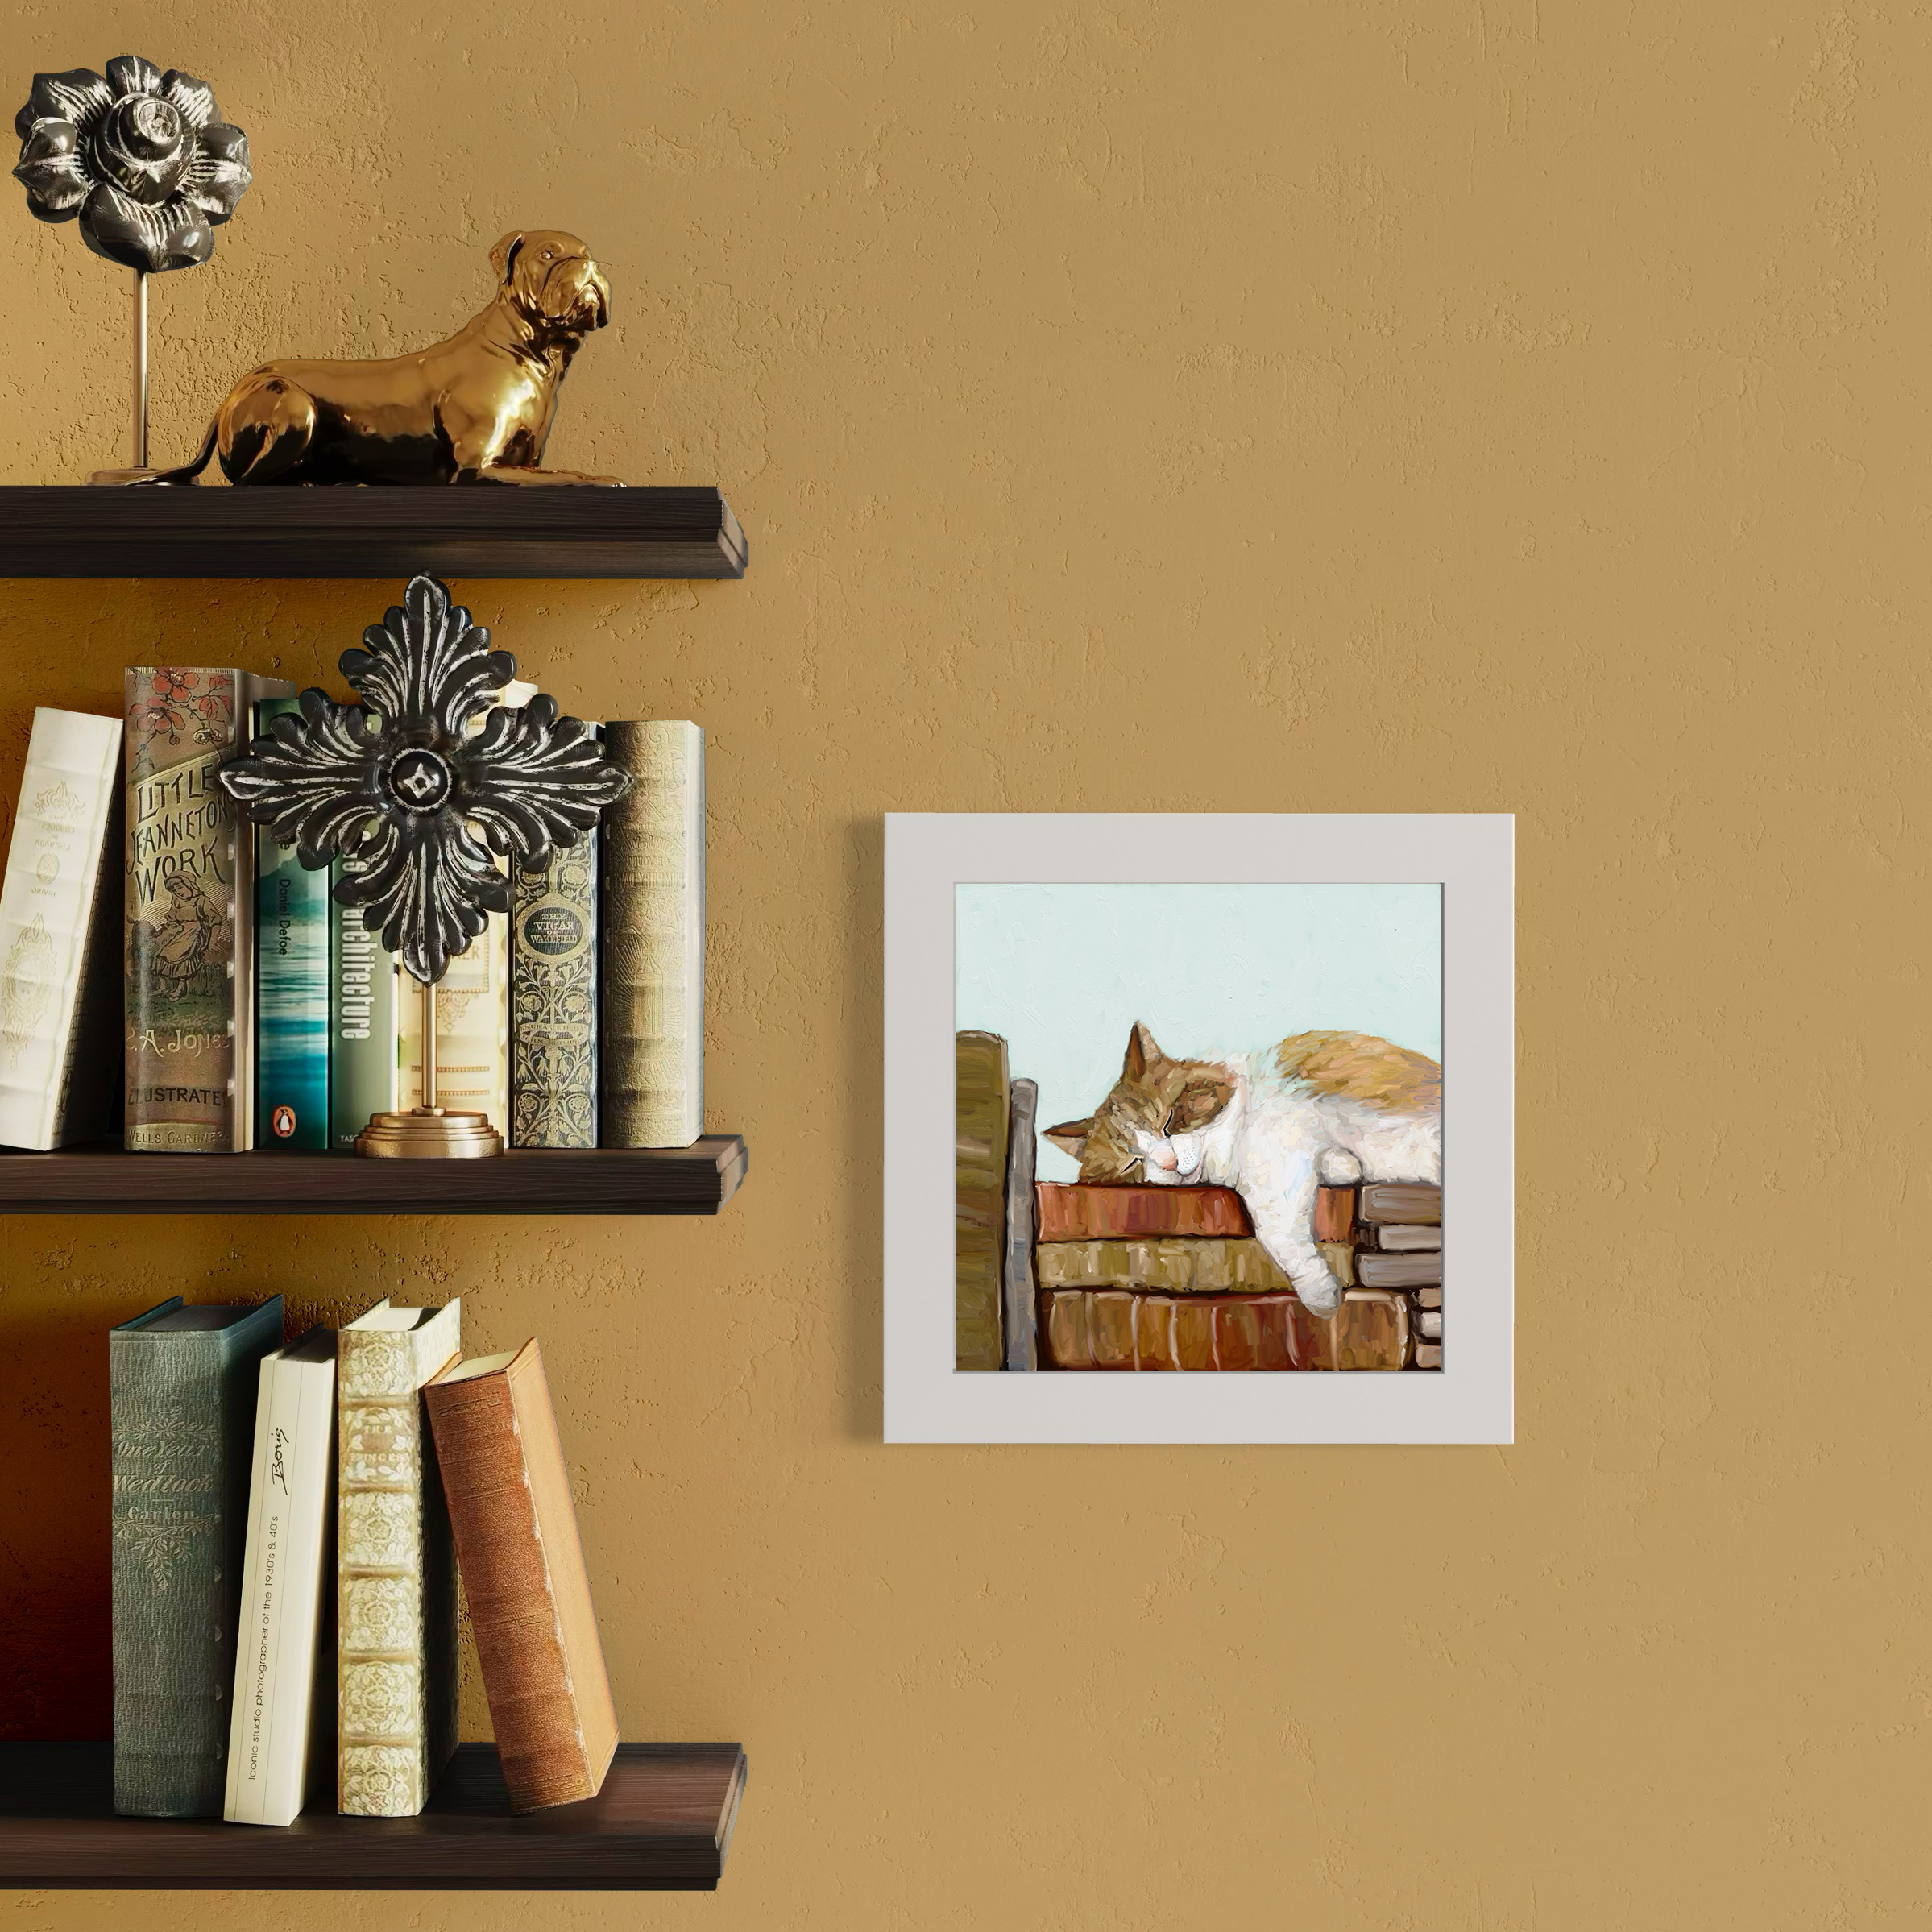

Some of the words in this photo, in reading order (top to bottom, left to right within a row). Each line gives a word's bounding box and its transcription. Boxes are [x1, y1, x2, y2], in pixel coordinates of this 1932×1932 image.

[137, 762, 215, 824] LITTLE
[135, 835, 226, 907] WORK
[278, 878, 292, 916] Daniel
[278, 919, 292, 956] Defoe
[530, 935, 578, 943] WAKEFIELD
[533, 921, 574, 931] VICAR
[341, 907, 375, 1040] architecture
[139, 1028, 164, 1058] A.
[127, 1129, 162, 1144] WELLS
[155, 1440, 206, 1457] Year
[270, 1427, 289, 1496] Boris
[153, 1459, 172, 1475] of
[113, 1473, 215, 1493] Wedlock
[127, 1505, 195, 1520] Carlen
[268, 1515, 279, 1539] 40's
[267, 1541, 276, 1550] &
[264, 1553, 276, 1587] 1930's
[263, 1591, 272, 1611] the
[260, 1613, 270, 1625] of
[255, 1627, 272, 1706] photographer
[251, 1709, 263, 1743] studio
[248, 1746, 259, 1781] Iconic
